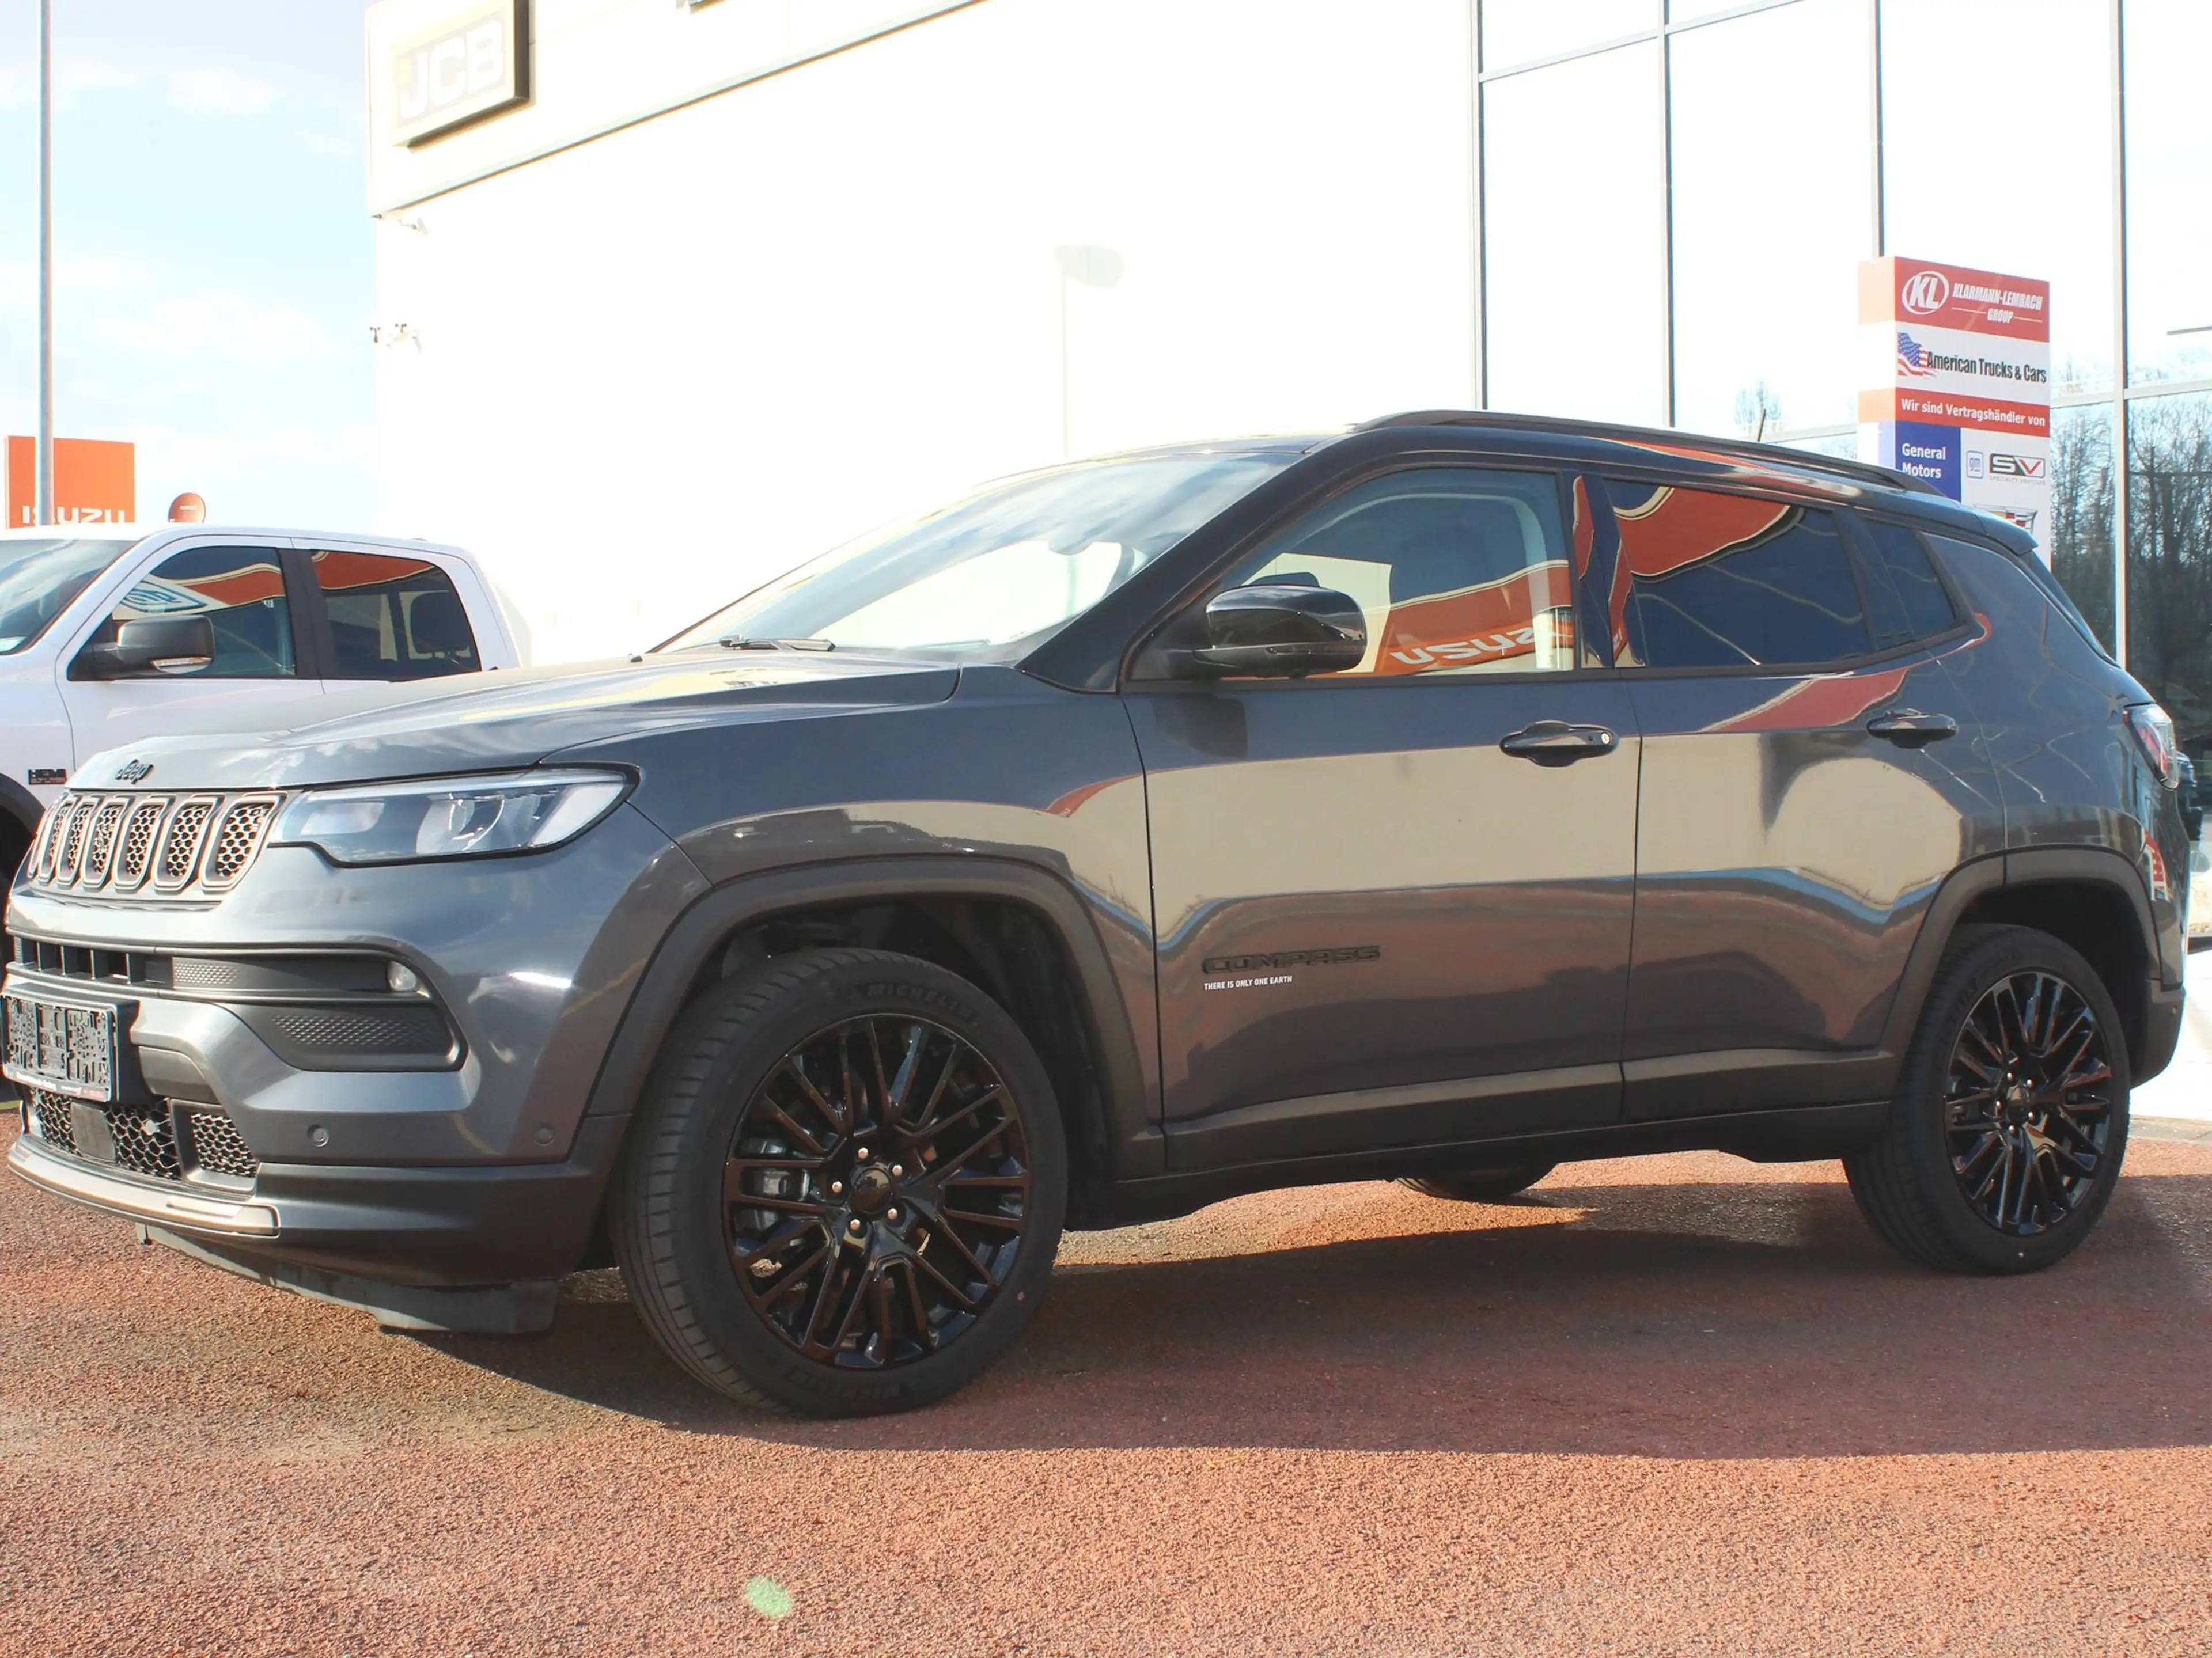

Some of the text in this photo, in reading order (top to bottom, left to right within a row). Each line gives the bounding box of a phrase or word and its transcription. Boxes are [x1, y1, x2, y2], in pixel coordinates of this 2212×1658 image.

[401, 21, 504, 119] JCB
[1910, 274, 1940, 309] KL
[1952, 283, 2043, 311] KLARMANN-LEMBACH
[1987, 308, 2014, 323] GROUP
[1927, 352, 2047, 384] American Trucks & Cars
[1902, 397, 2046, 427] Wir sind Vertragshändler von
[1902, 443, 1946, 461] General
[1902, 462, 1942, 479] Motors
[1991, 455, 2044, 477] SV
[22, 505, 126, 523] IUZU
[115, 759, 154, 785] Jeep
[1202, 946, 1381, 974] COMPASS
[1204, 976, 1293, 991] THERE IS ONLY ONE EARTH
